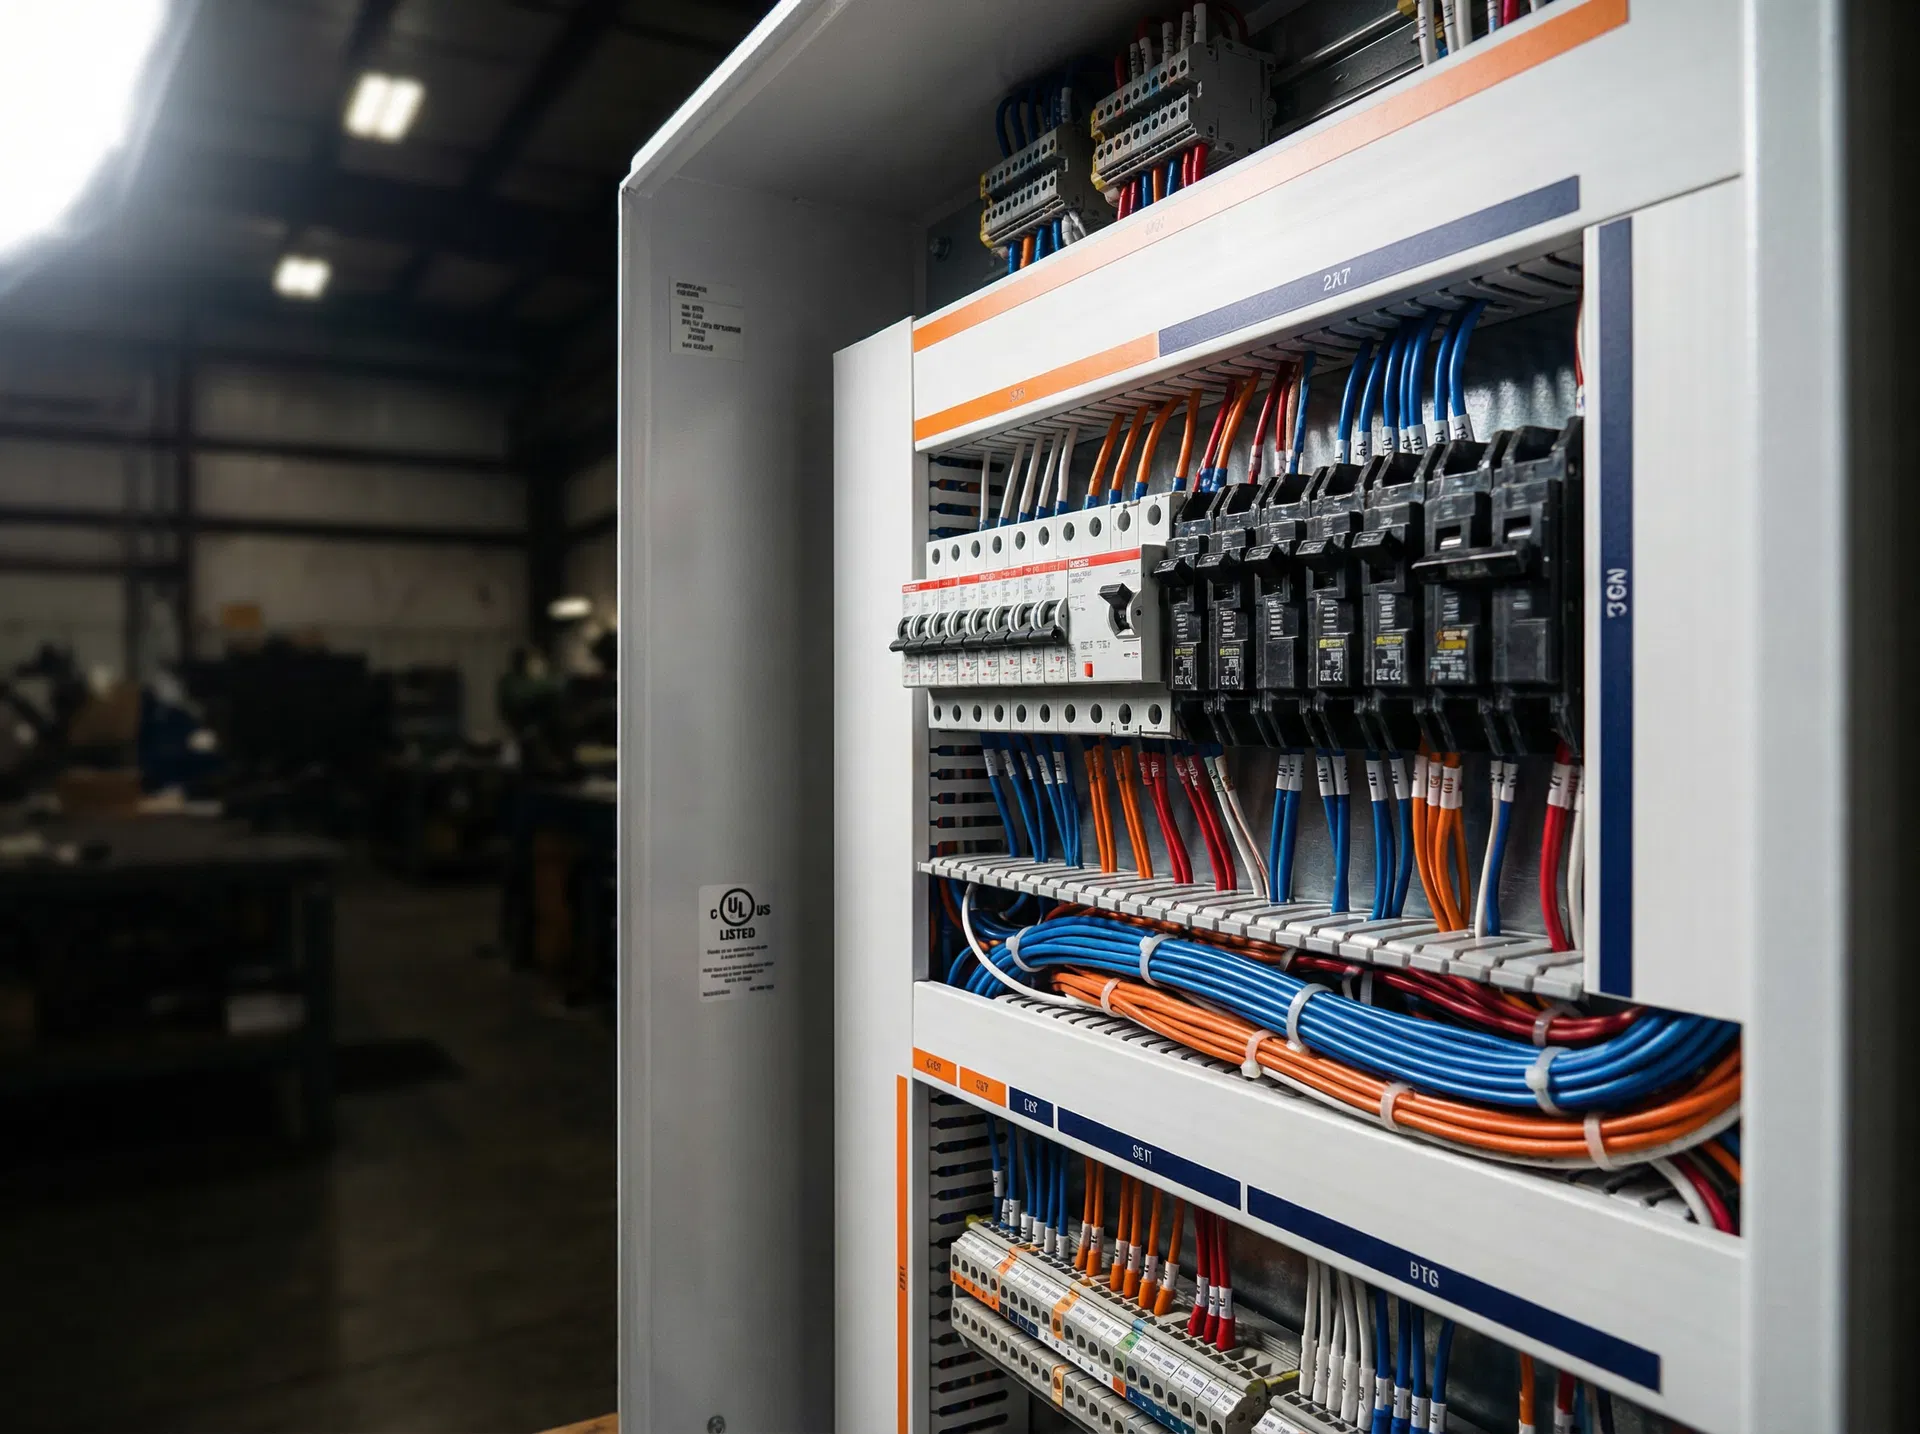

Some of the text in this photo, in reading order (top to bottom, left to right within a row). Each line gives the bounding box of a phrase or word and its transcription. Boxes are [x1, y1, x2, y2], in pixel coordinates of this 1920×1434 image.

[728, 897, 747, 918] UL
[757, 904, 771, 916] US
[720, 927, 756, 941] LISTED
